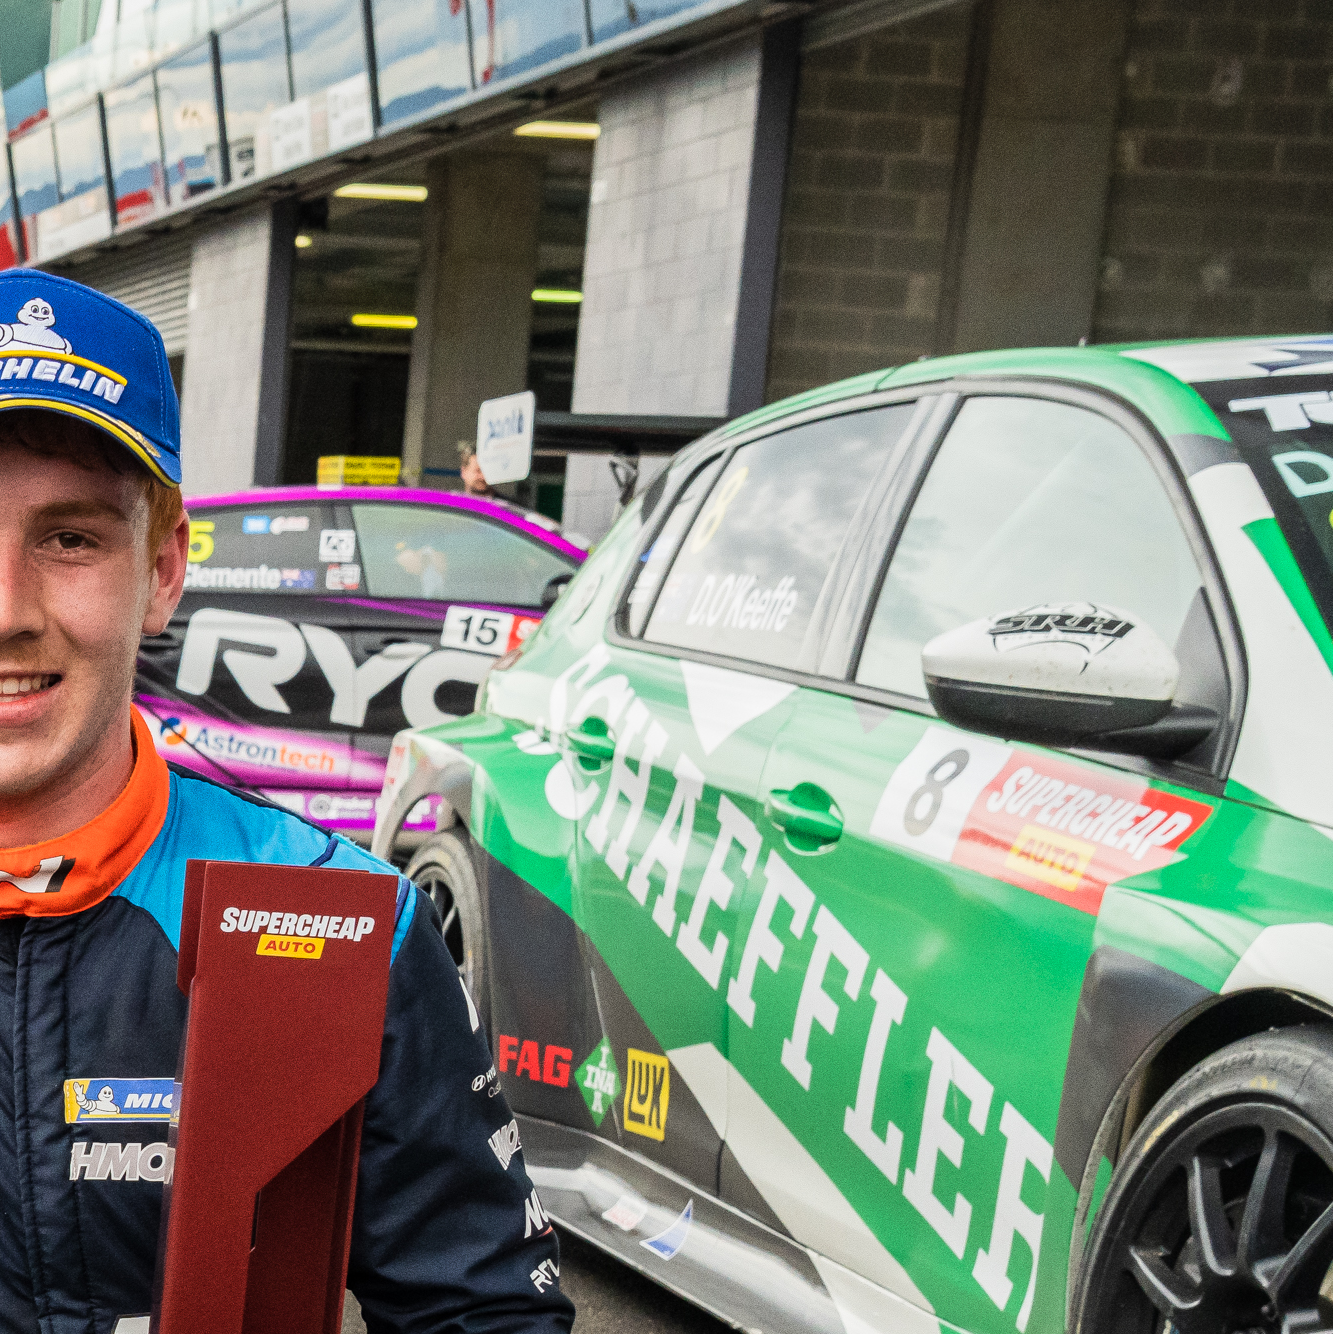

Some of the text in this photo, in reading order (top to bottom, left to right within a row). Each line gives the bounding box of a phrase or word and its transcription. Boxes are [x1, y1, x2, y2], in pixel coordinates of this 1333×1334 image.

[460, 613, 500, 645] 15
[194, 727, 334, 772] Astrontech
[903, 748, 970, 837] 8
[985, 766, 1193, 862] SUPERCHEAP
[1013, 839, 1085, 876] AUTO
[220, 907, 375, 942] SUPERCHEAP
[264, 941, 316, 954] AUTO
[499, 1034, 573, 1088] FAG
[69, 1142, 171, 1182] HMO
